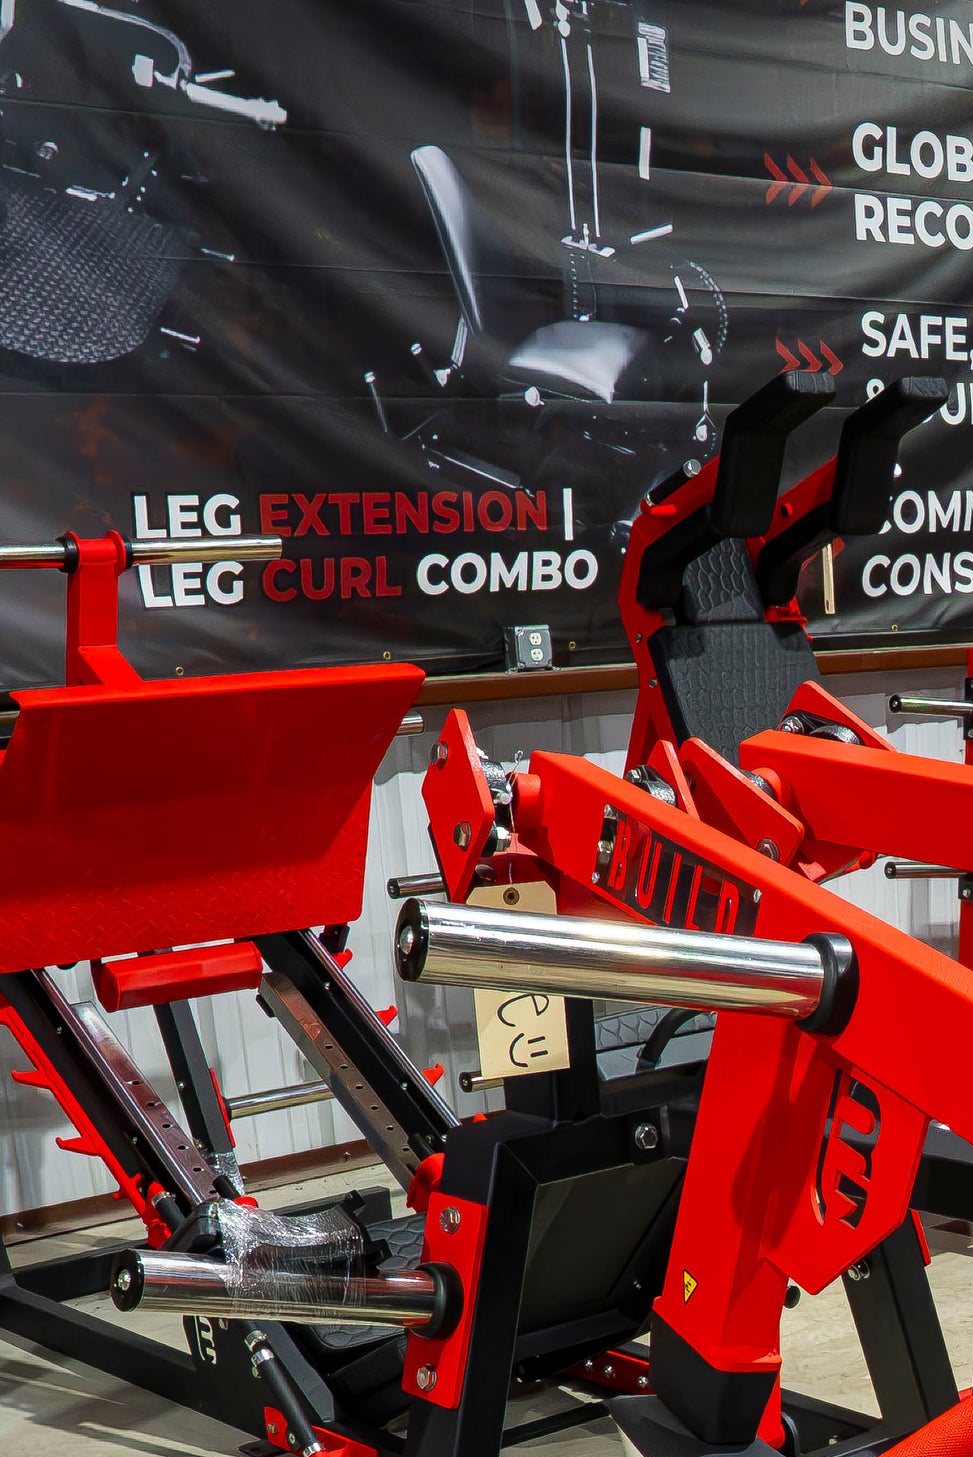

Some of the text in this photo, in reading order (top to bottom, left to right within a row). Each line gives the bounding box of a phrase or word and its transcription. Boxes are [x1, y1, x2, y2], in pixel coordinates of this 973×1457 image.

[133, 493, 241, 538] LEG
[259, 490, 547, 537] EXTENSION
[138, 549, 598, 608] LEG CURL COMBO
[608, 820, 740, 934] BUILD
